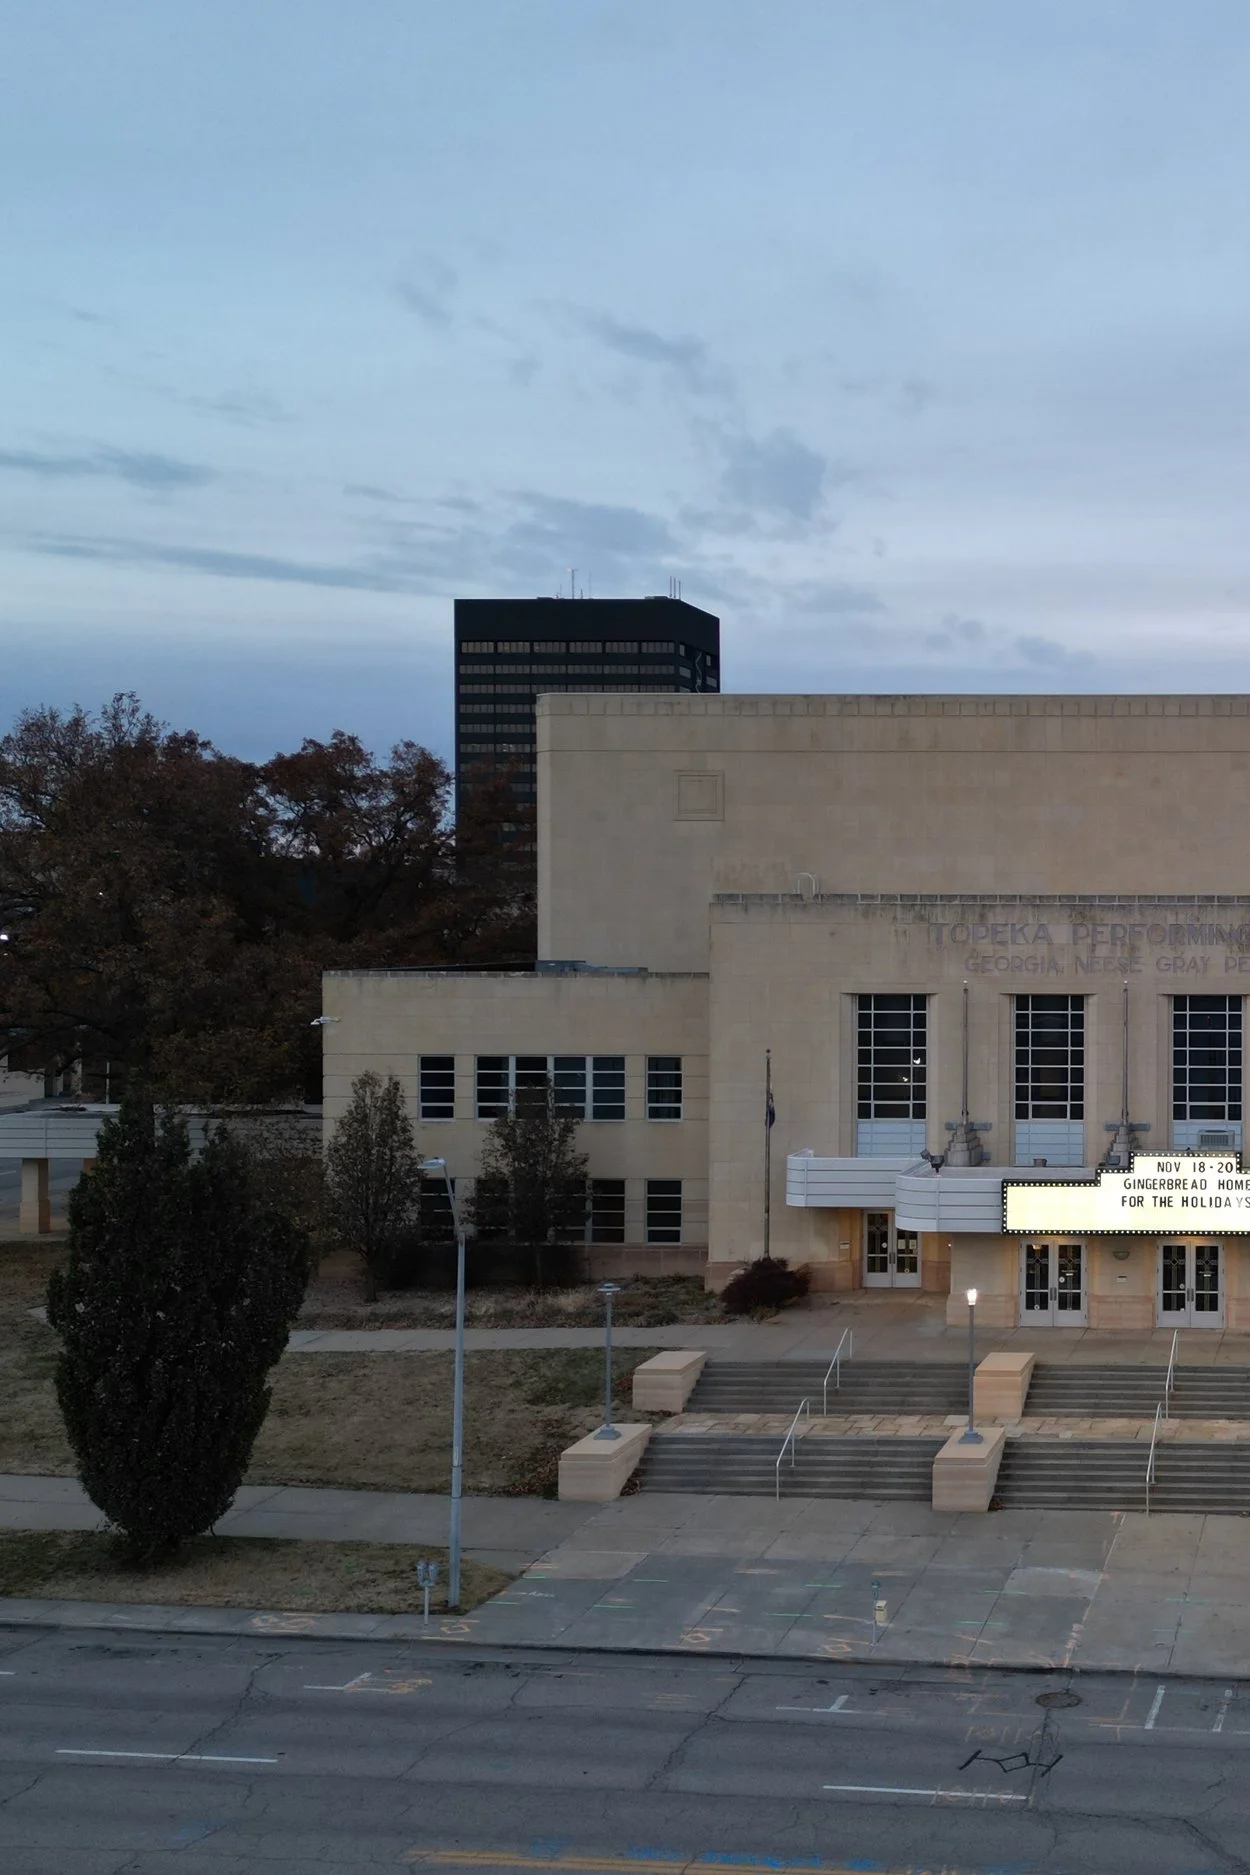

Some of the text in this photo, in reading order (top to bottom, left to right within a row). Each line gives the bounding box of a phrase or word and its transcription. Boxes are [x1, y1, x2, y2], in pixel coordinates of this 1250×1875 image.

[929, 922, 1053, 946] TOPEKA
[964, 955, 1061, 974] GEORGIA
[1074, 956, 1144, 974] NEESE
[1155, 956, 1212, 974] GRAY
[1157, 1161, 1181, 1173] NOV
[1123, 1178, 1208, 1190] GINGERBREAD
[1121, 1196, 1144, 1208] FOR
[1152, 1196, 1174, 1208] THE
